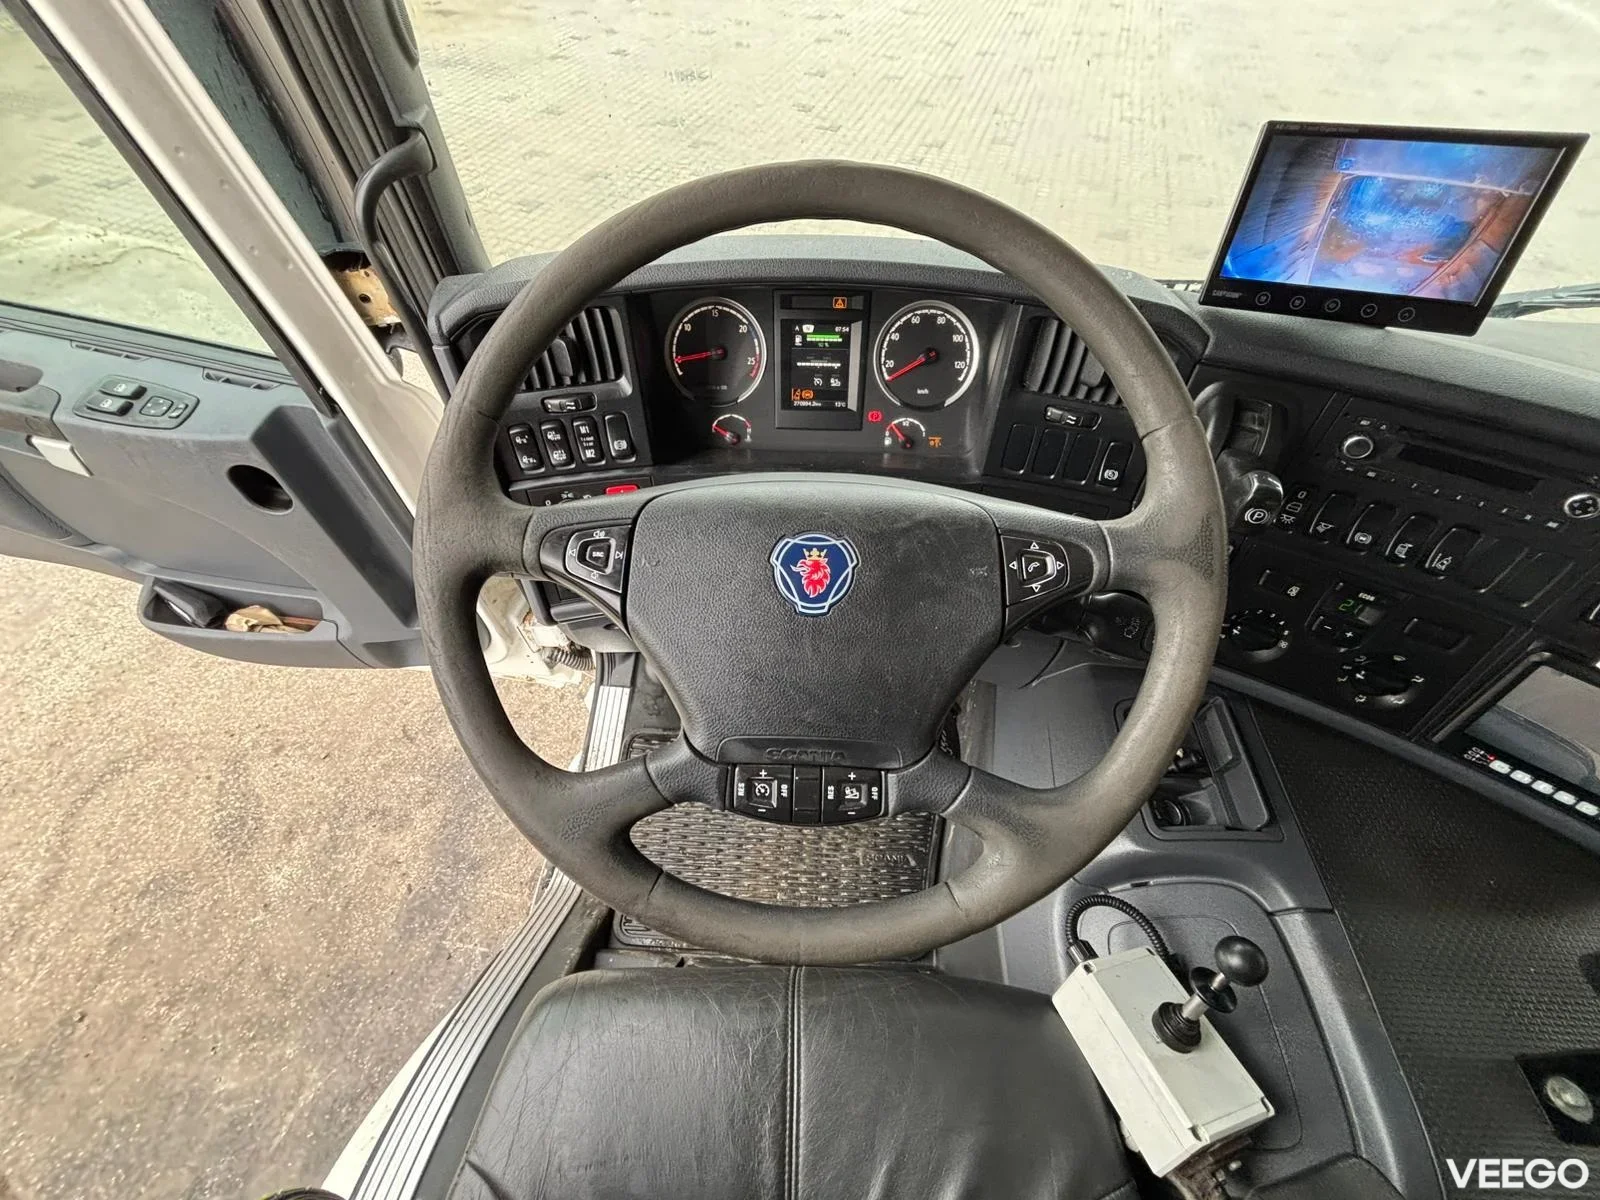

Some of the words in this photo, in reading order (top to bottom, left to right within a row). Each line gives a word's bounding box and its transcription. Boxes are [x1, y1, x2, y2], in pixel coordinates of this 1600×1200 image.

[711, 309, 719, 317] 15
[911, 316, 920, 324] 60
[936, 316, 946, 325] 80
[683, 323, 692, 332] 10
[738, 324, 748, 333] 20
[890, 332, 900, 341] 40
[952, 334, 964, 343] 100
[747, 357, 756, 365] 25
[885, 360, 895, 368] 20
[954, 361, 966, 369] 120
[579, 425, 590, 434] M1
[585, 448, 596, 458] M2
[765, 747, 848, 761] SCANIA
[737, 782, 745, 797] RES
[780, 783, 788, 798] OFF
[827, 785, 835, 800] RES
[871, 786, 879, 801] OFF
